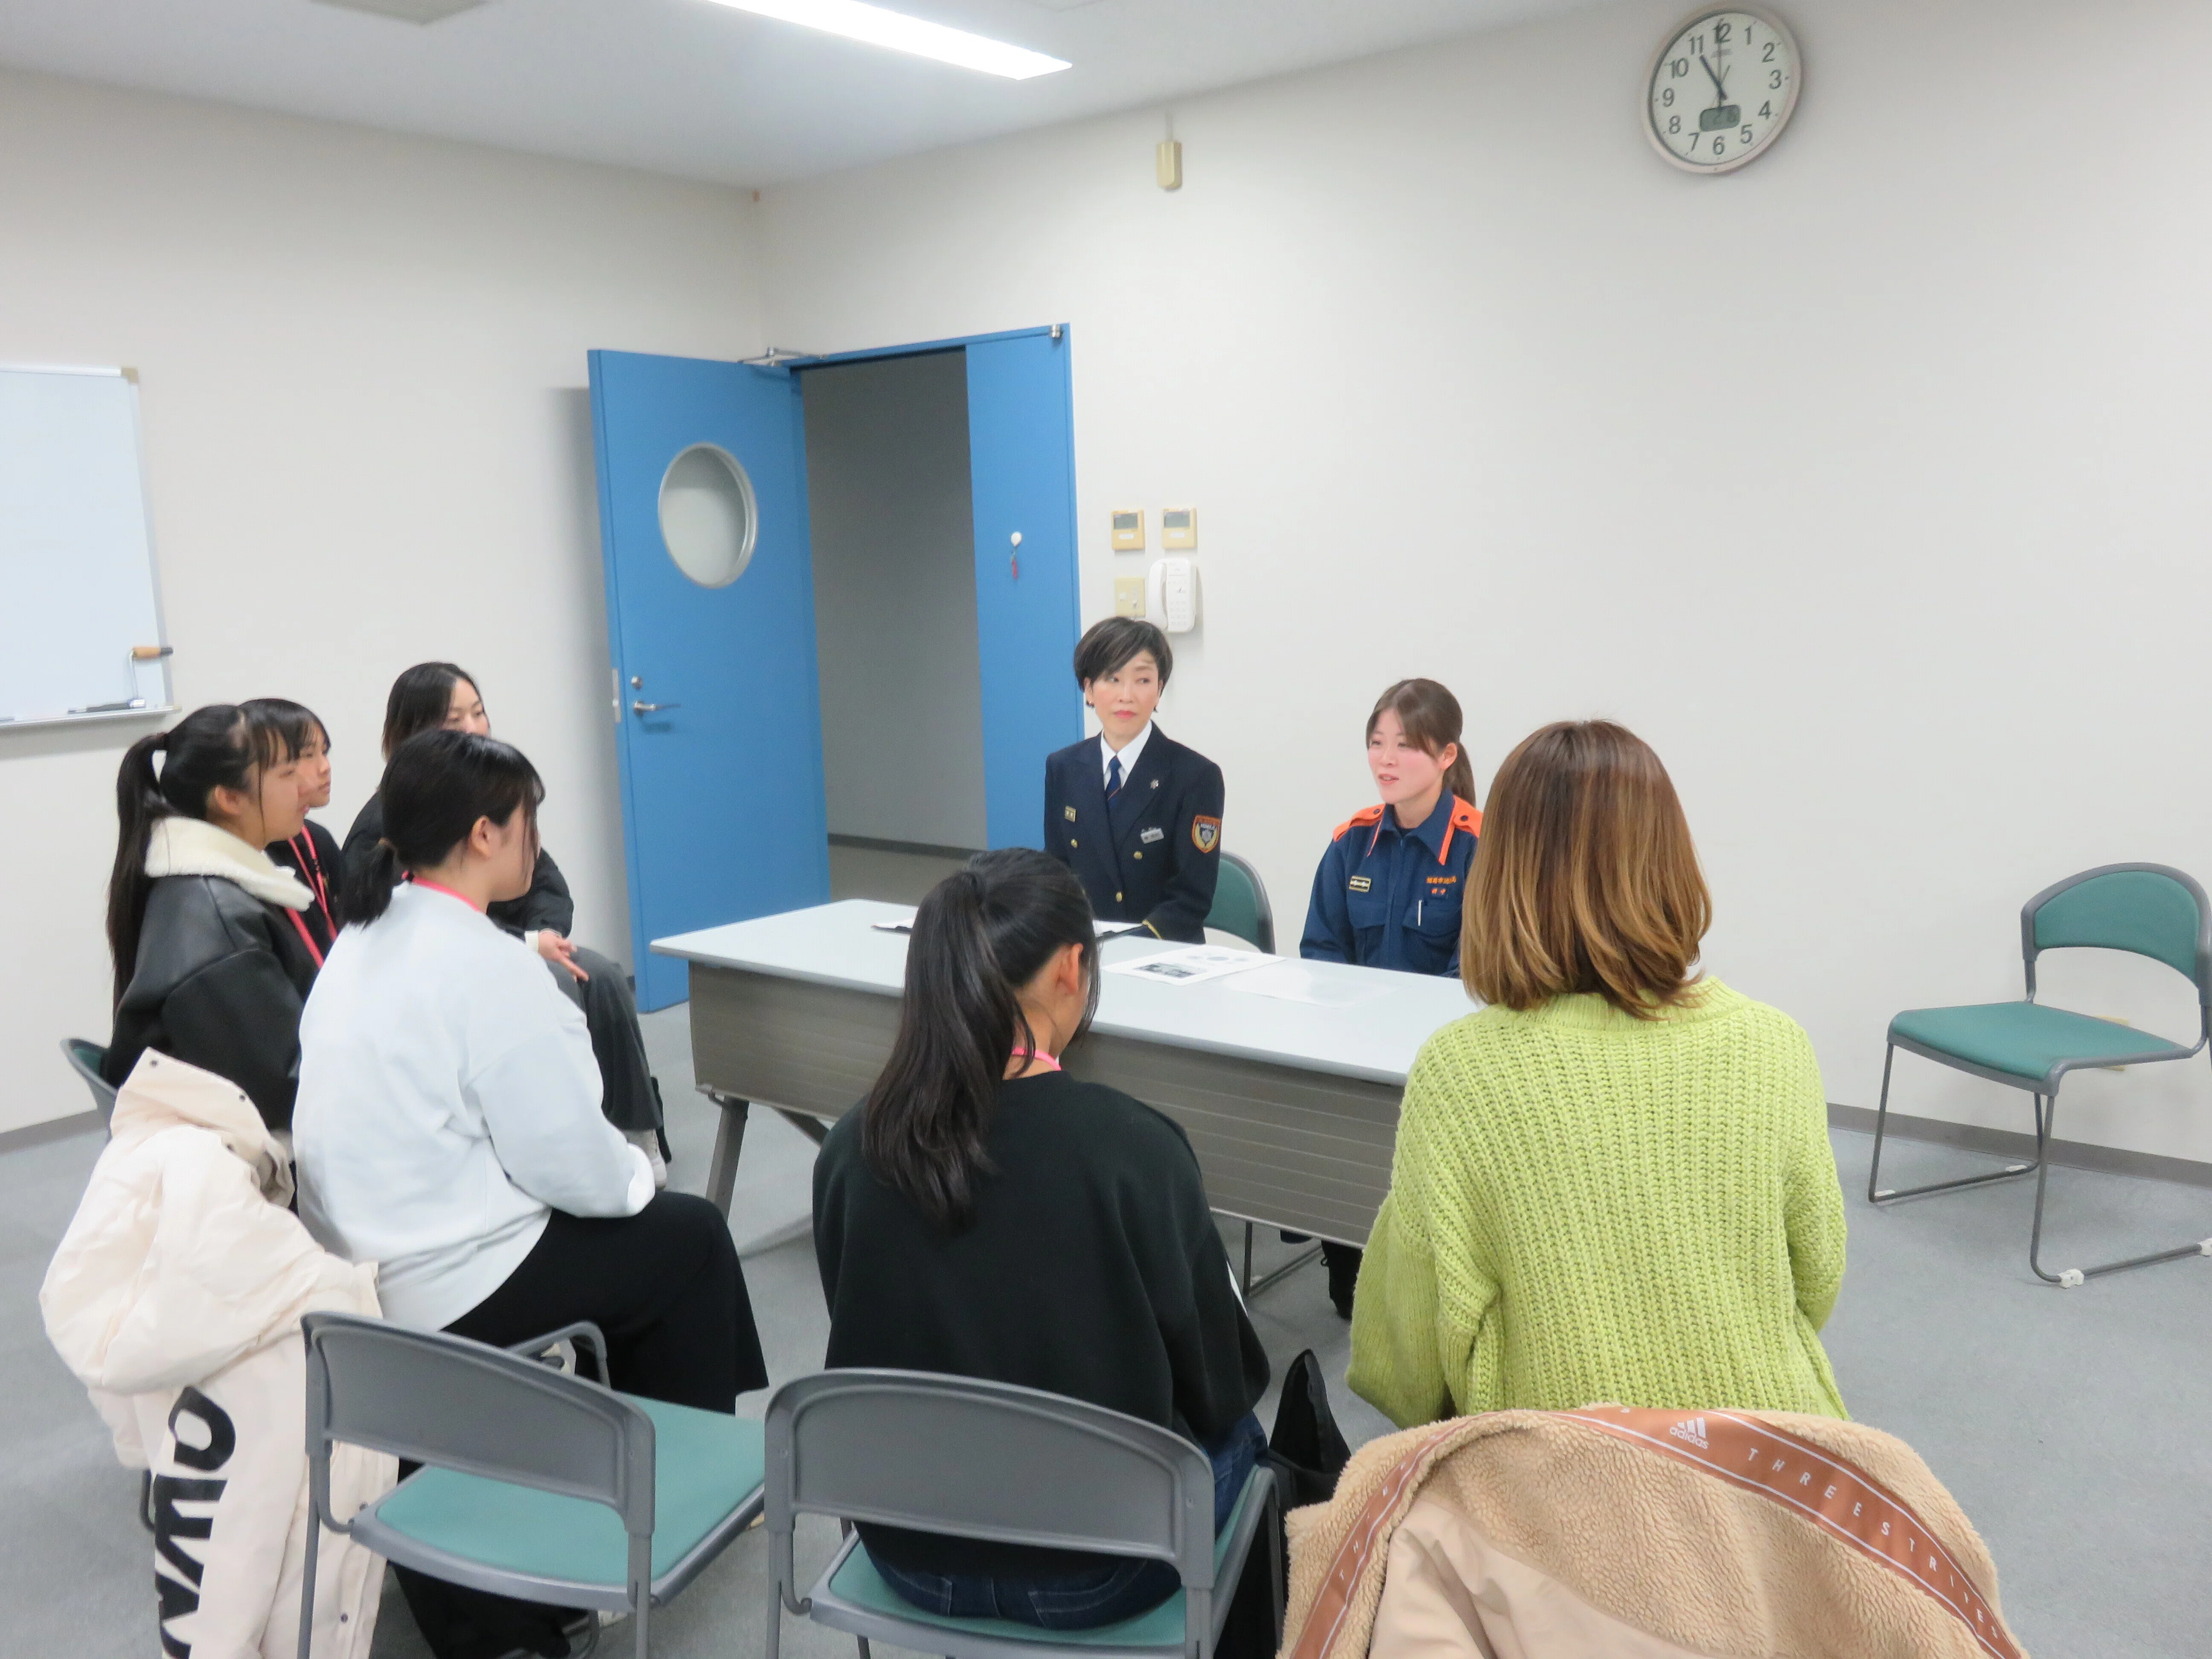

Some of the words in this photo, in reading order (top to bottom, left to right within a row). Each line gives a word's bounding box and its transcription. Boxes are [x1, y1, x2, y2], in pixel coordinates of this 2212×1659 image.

[1688, 35, 1704, 55] 11
[1744, 26, 1752, 46] 1
[1762, 41, 1775, 63] 2
[1668, 57, 1689, 79] 10
[1769, 69, 1782, 90] 3
[1662, 88, 1675, 107] 9
[1758, 100, 1773, 119] 4
[1668, 115, 1682, 134] 8
[1740, 124, 1753, 144] 5
[1688, 132, 1700, 152] 7
[1712, 136, 1726, 155] 6
[1669, 1426, 1709, 1449] adidas
[1748, 1447, 1863, 1517] THREE
